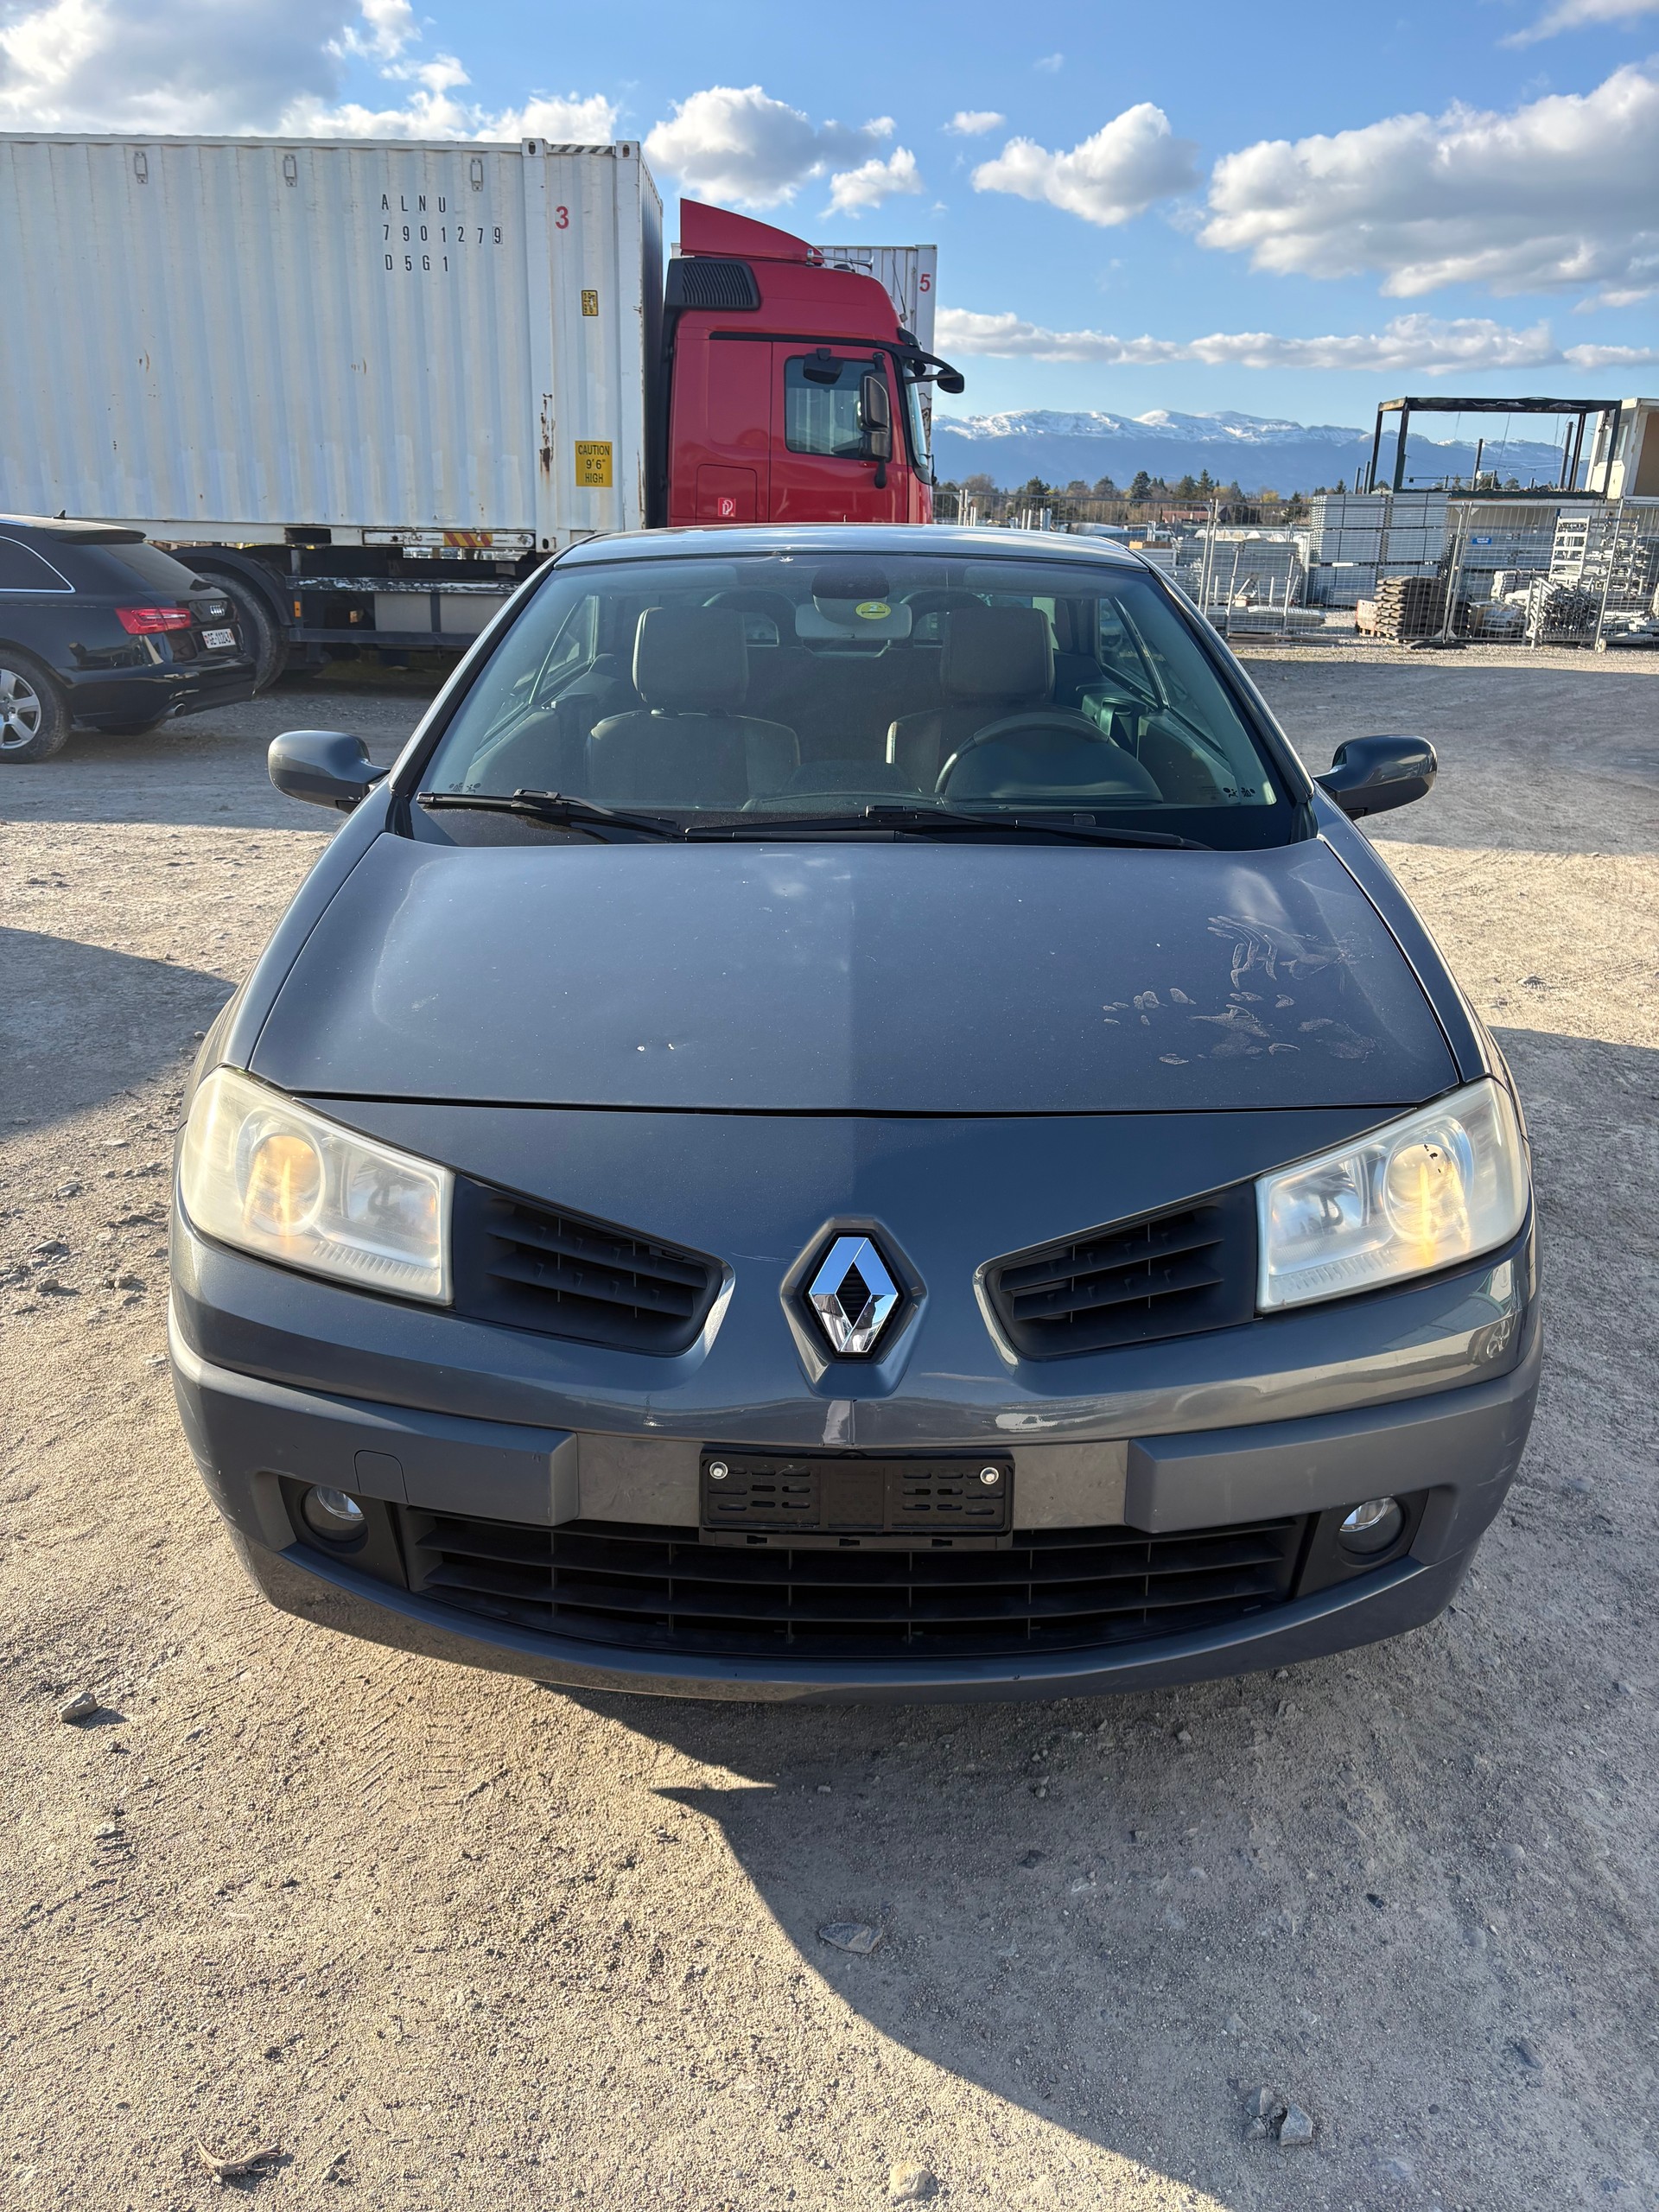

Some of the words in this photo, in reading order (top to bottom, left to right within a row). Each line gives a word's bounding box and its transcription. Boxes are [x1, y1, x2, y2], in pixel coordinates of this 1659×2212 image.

[381, 194, 446, 213] ALNU
[556, 206, 569, 229] 3
[385, 254, 448, 272] D5G1
[919, 273, 931, 292] 5
[578, 444, 610, 455] CAUTION
[585, 473, 604, 483] HIGH
